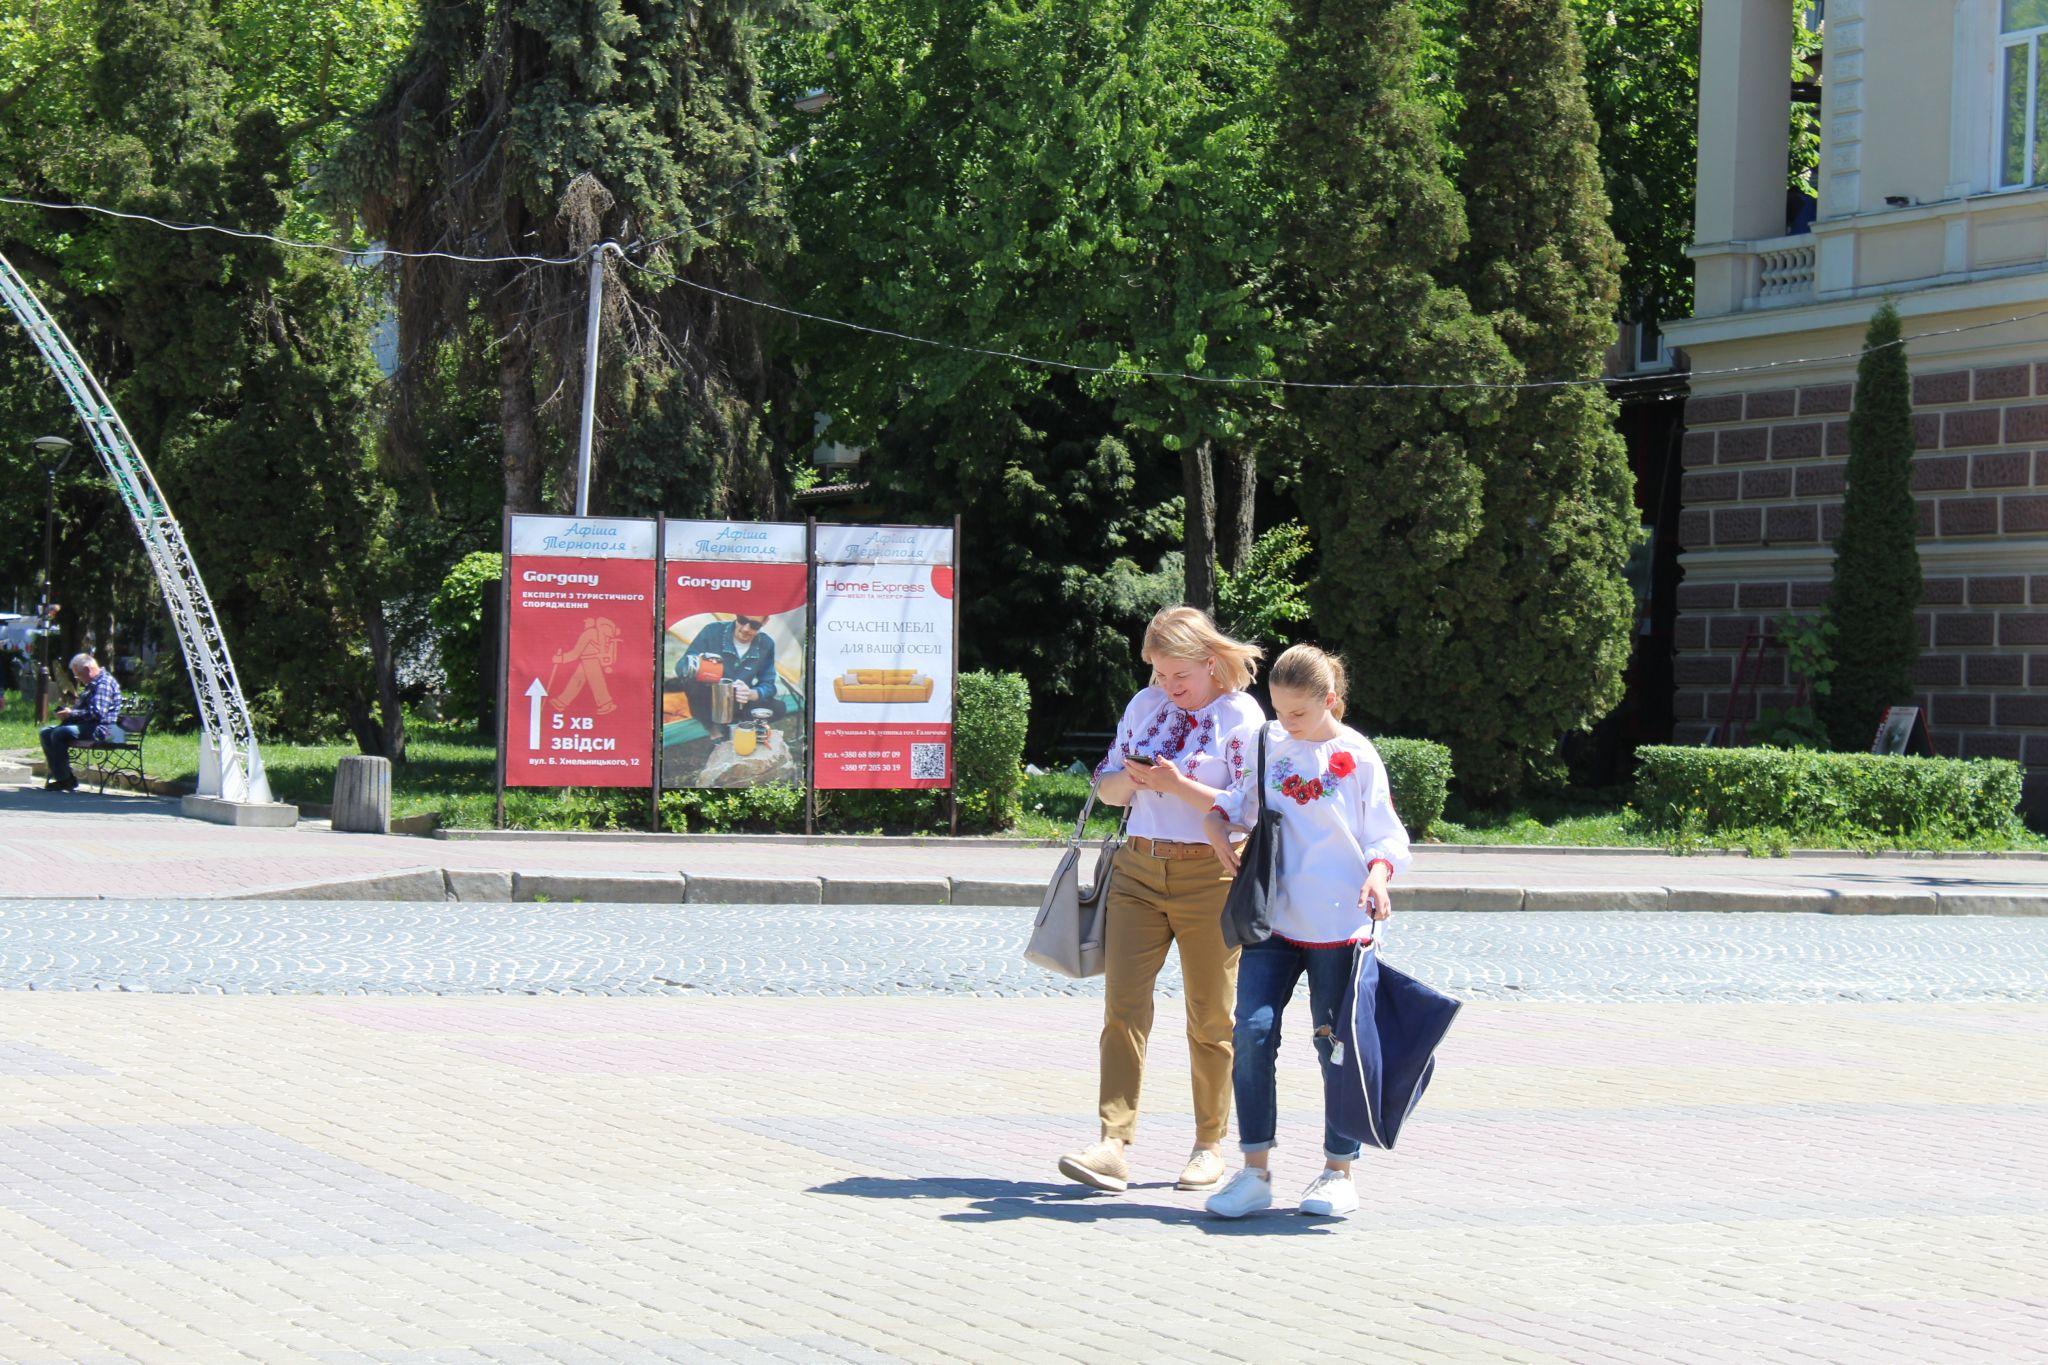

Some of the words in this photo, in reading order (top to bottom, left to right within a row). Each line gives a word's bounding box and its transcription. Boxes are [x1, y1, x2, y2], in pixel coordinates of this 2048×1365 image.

[564, 523, 617, 538] Афіша
[716, 527, 768, 541] Афіша
[543, 536, 626, 551] Тернополя
[695, 539, 777, 554] Тернополя
[523, 570, 599, 586] Gorgany
[677, 576, 751, 591] Gorgany
[825, 580, 869, 592] Home
[872, 581, 925, 595] Express
[522, 591, 566, 599] ЕКСПЕРТИ
[576, 592, 644, 601] ТУРИСТИЧНОГО
[522, 601, 589, 609] СПОРЯДЖЕННЯ
[828, 620, 889, 633] СУЧАСНІ
[893, 621, 935, 633] МЕБЛІ
[840, 643, 863, 655] ДЛЯ
[866, 643, 904, 654] ВАШОЇ
[907, 644, 941, 655] ОСЕЛІ
[552, 714, 564, 730] 5
[570, 717, 594, 730] хв
[551, 734, 616, 752] звідси
[529, 758, 546, 766] вул.
[549, 757, 557, 765] Б.
[560, 758, 629, 767] Хмельницького,
[630, 758, 640, 766] 12
[892, 764, 901, 772] 19
